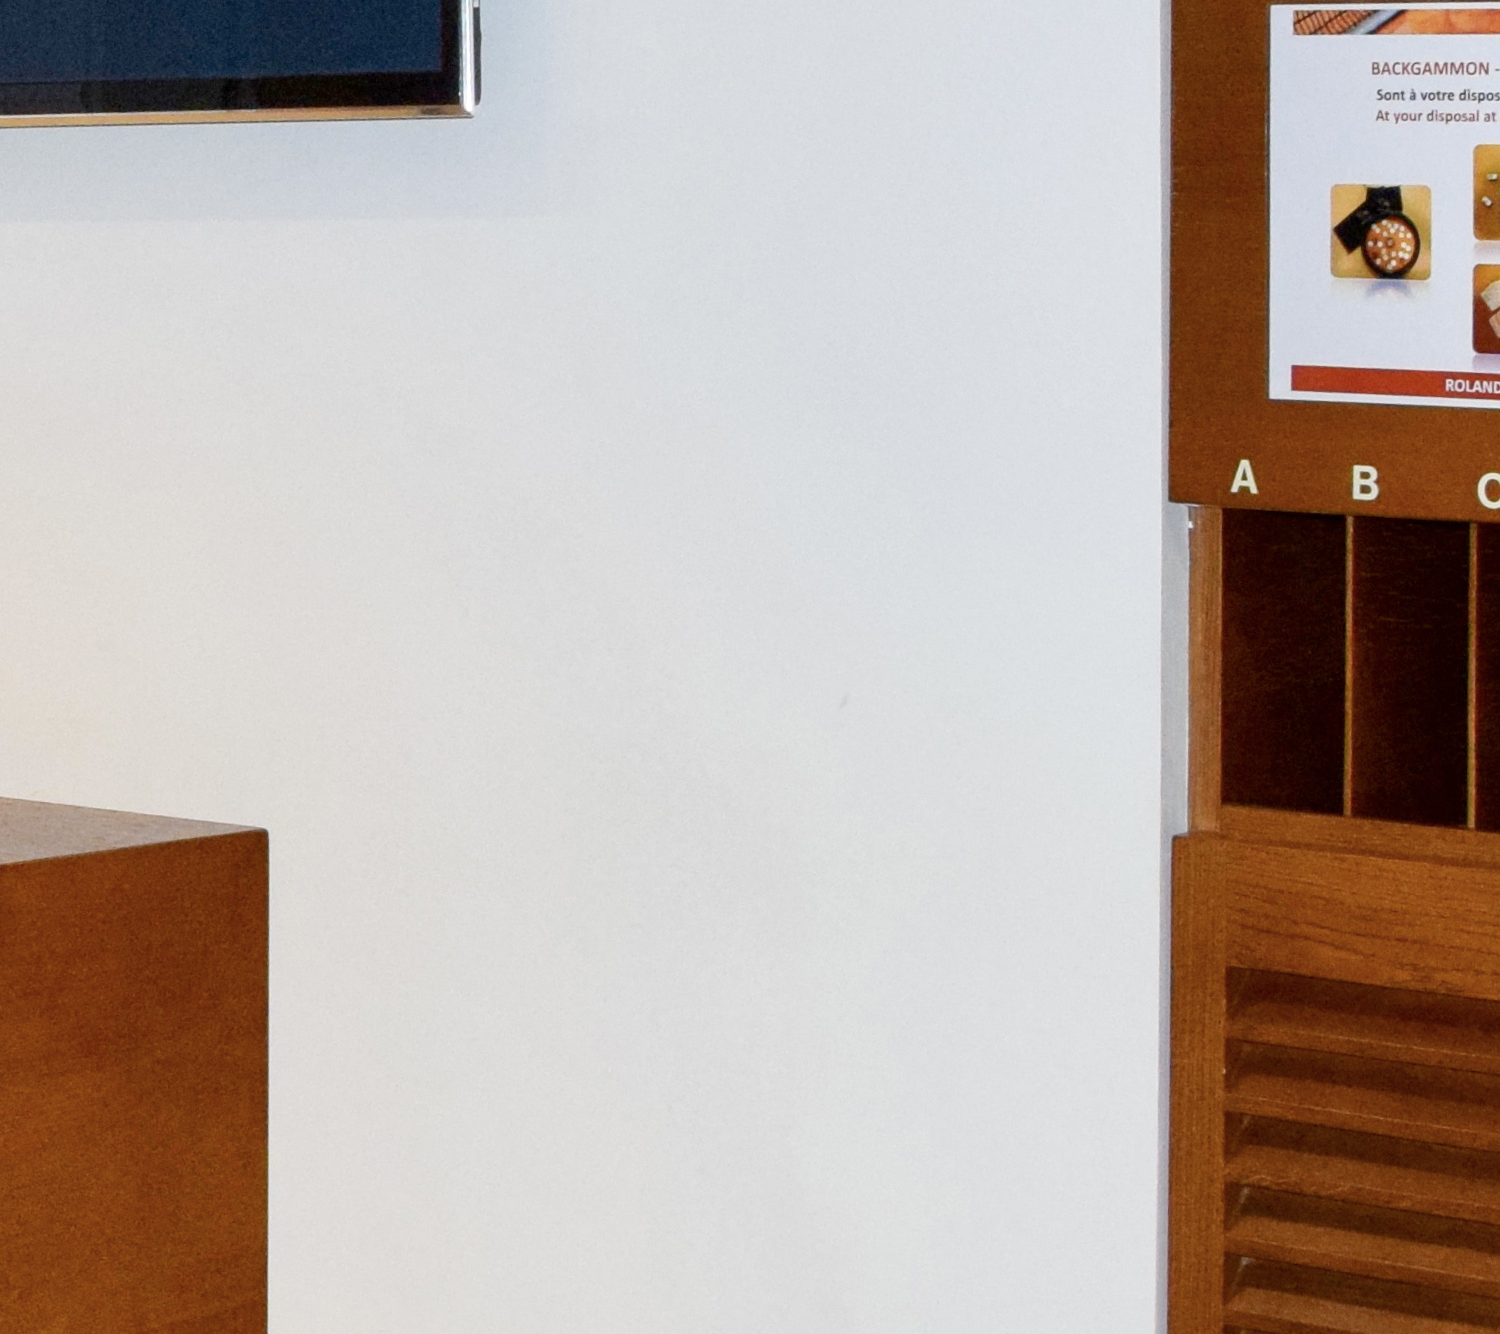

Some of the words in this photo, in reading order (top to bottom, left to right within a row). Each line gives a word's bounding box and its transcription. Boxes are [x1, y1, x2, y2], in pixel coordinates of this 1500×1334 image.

[1371, 61, 1489, 75] BACKGAMMON
[1376, 88, 1405, 101] Sont
[1408, 88, 1416, 101] à
[1420, 90, 1455, 101] votre
[1375, 109, 1390, 122] At
[1393, 112, 1423, 124] your
[1426, 109, 1480, 124] disposal
[1483, 111, 1496, 122] at
[1231, 460, 1257, 494] A
[1353, 465, 1378, 500] B
